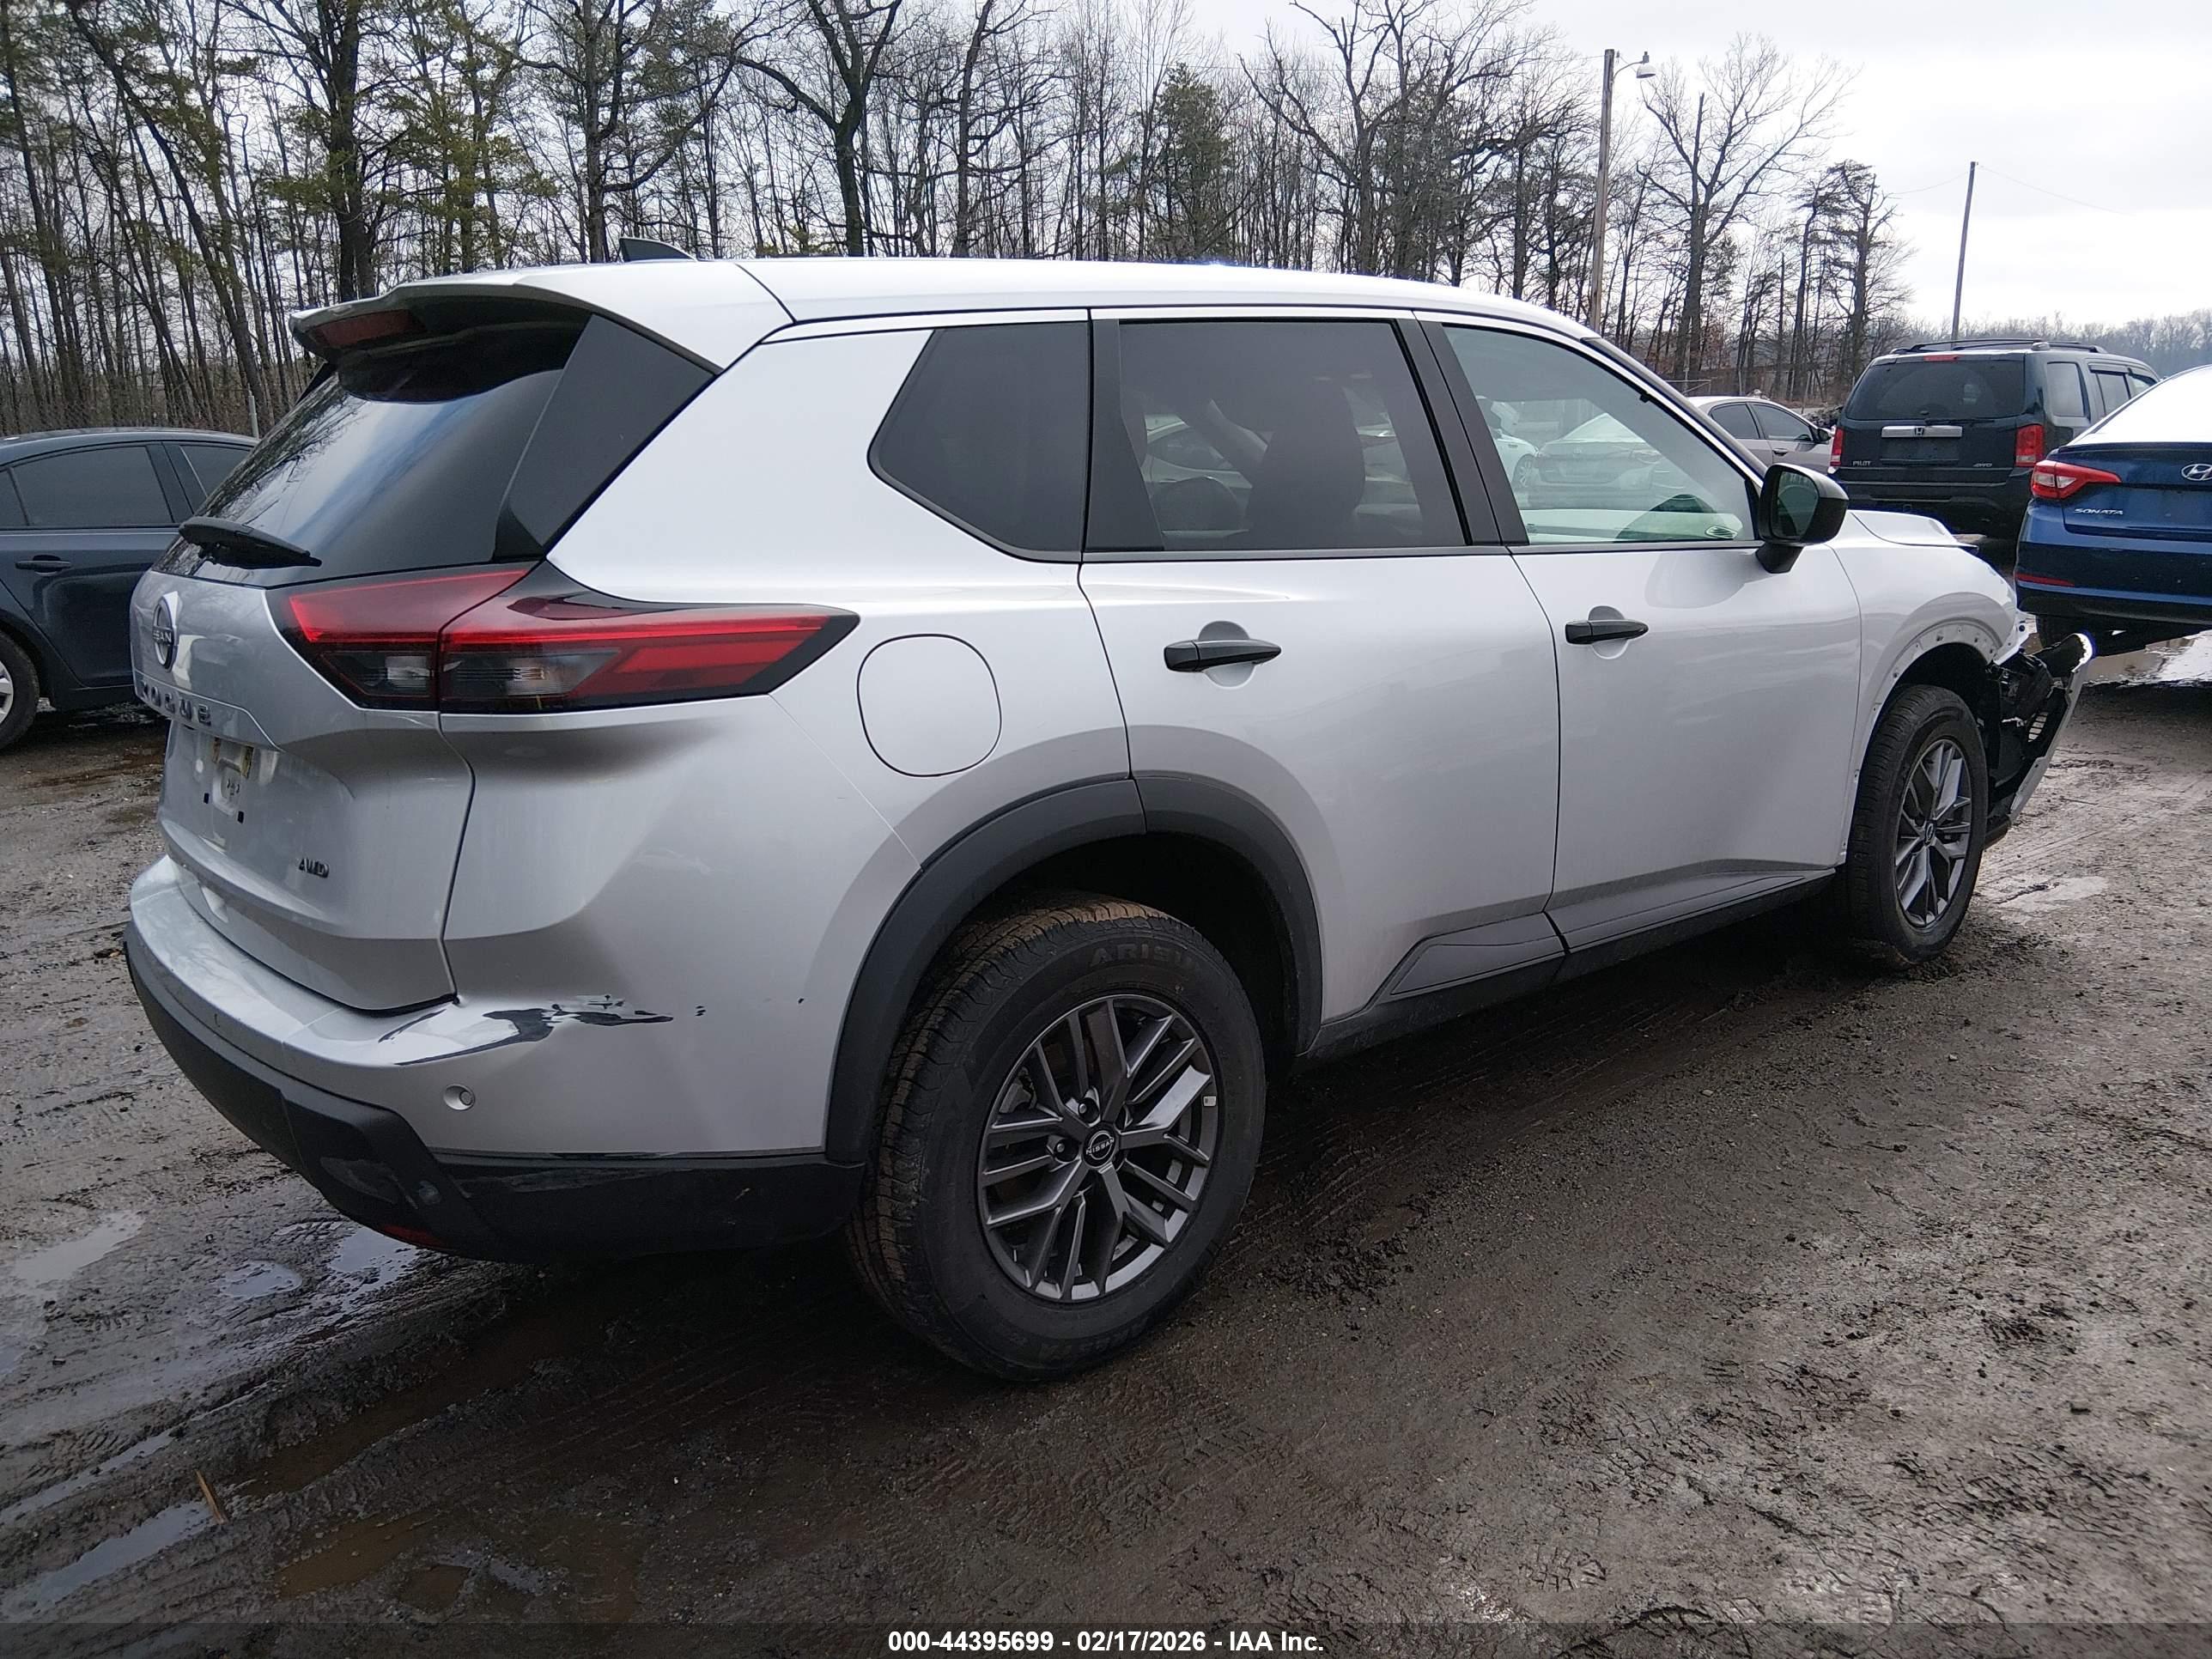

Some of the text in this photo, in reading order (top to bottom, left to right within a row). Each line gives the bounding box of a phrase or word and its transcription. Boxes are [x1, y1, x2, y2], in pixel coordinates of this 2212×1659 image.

[2074, 507, 2124, 516] SONATA
[298, 857, 330, 879] AWD
[1085, 1137, 1115, 1155] NISSAN
